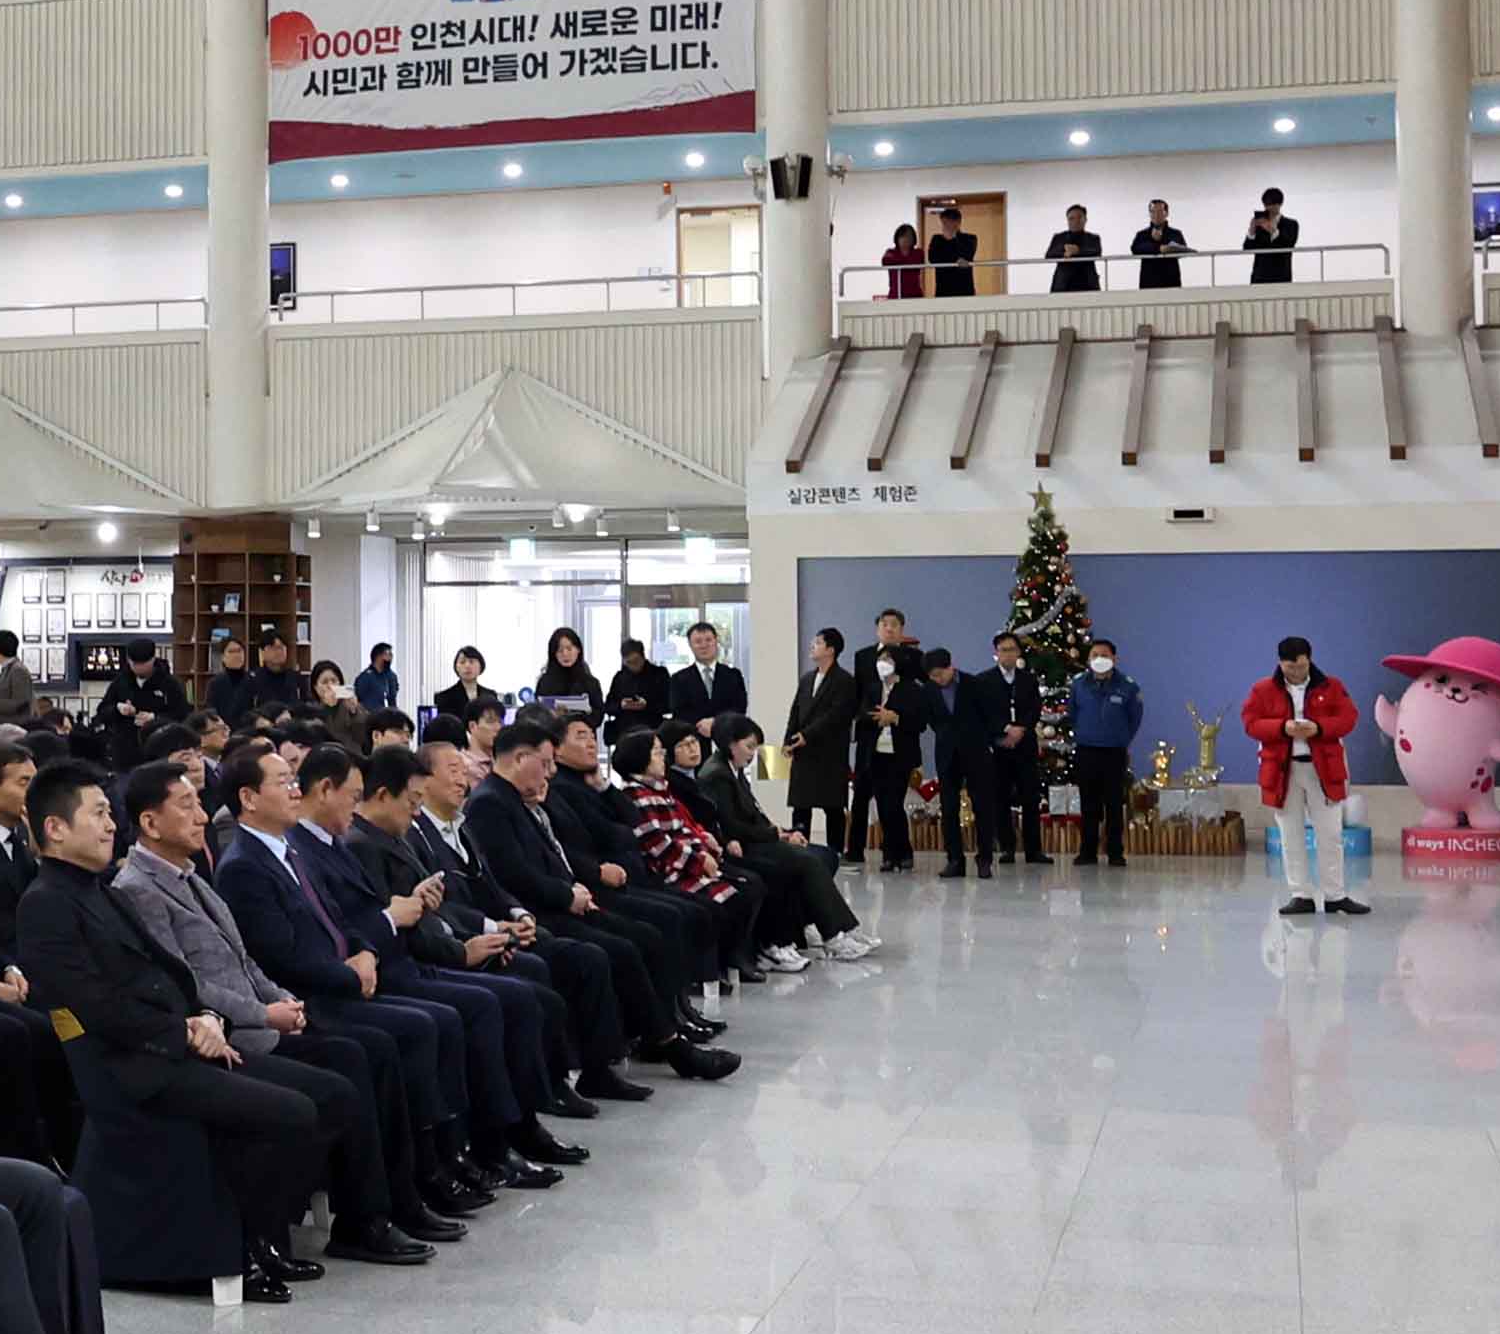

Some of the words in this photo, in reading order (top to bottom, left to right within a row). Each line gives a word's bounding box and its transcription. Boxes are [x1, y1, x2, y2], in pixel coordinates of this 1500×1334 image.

[297, 26, 402, 61] 1000만
[410, 14, 539, 51] 인천시대!
[550, 7, 638, 40] 새로운
[649, 2, 723, 32] 미래!
[302, 64, 388, 97] 시민과
[396, 58, 452, 90] 함께
[462, 52, 549, 85] 만들어
[559, 40, 719, 77] 가겠습니다.
[788, 486, 861, 505] 실감콘텐츠
[872, 485, 918, 503] 체험존
[1416, 837, 1446, 851] ways
